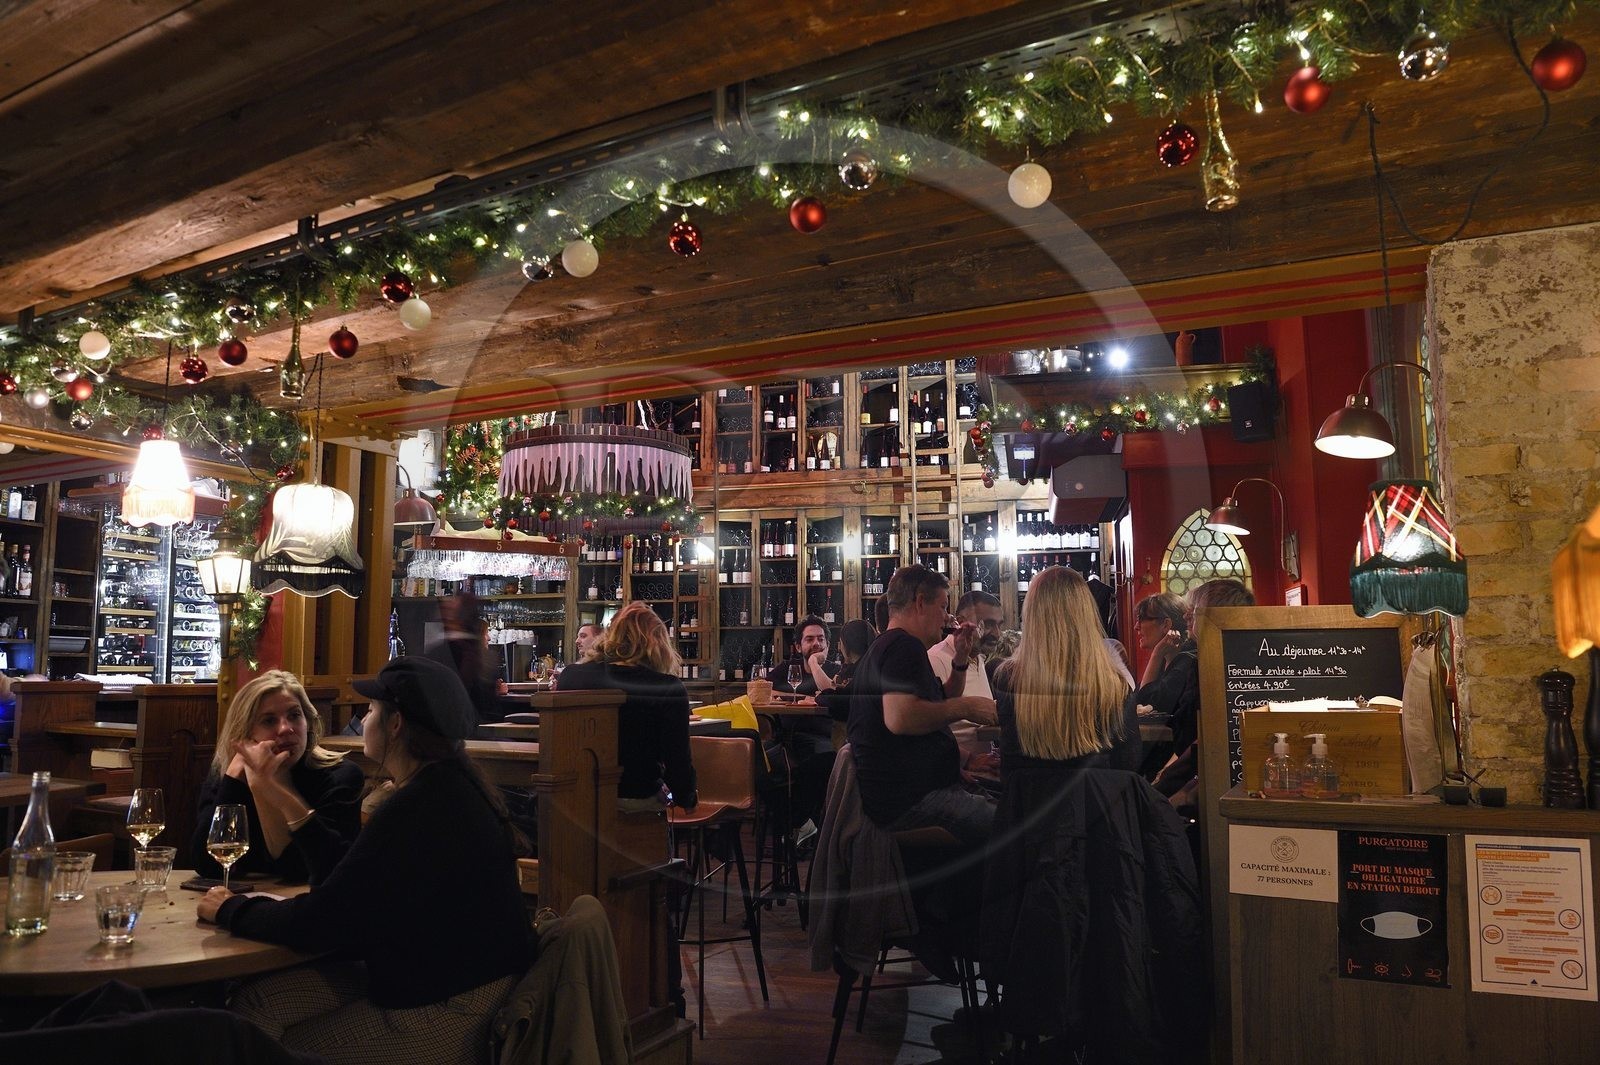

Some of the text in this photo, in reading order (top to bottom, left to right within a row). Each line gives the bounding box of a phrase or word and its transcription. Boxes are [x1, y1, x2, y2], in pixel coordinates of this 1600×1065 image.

[496, 542, 502, 551] 5
[559, 545, 565, 554] 6
[1258, 638, 1280, 656] Au
[1282, 644, 1326, 660] déjeuner
[1228, 664, 1263, 676] Formule
[1265, 666, 1295, 676] entrée
[1228, 681, 1261, 690] Entrées
[1358, 836, 1429, 848] PURGATOIRE
[1240, 862, 1280, 872] CAPACITÉ
[1281, 865, 1327, 876] MAXIMALE
[1352, 863, 1433, 877] PORT DU MASQUE
[1266, 876, 1313, 886] PERSONNES
[1362, 873, 1426, 885] OBLIGATOIRE
[1346, 881, 1441, 895] EN STATION DEBOUT
